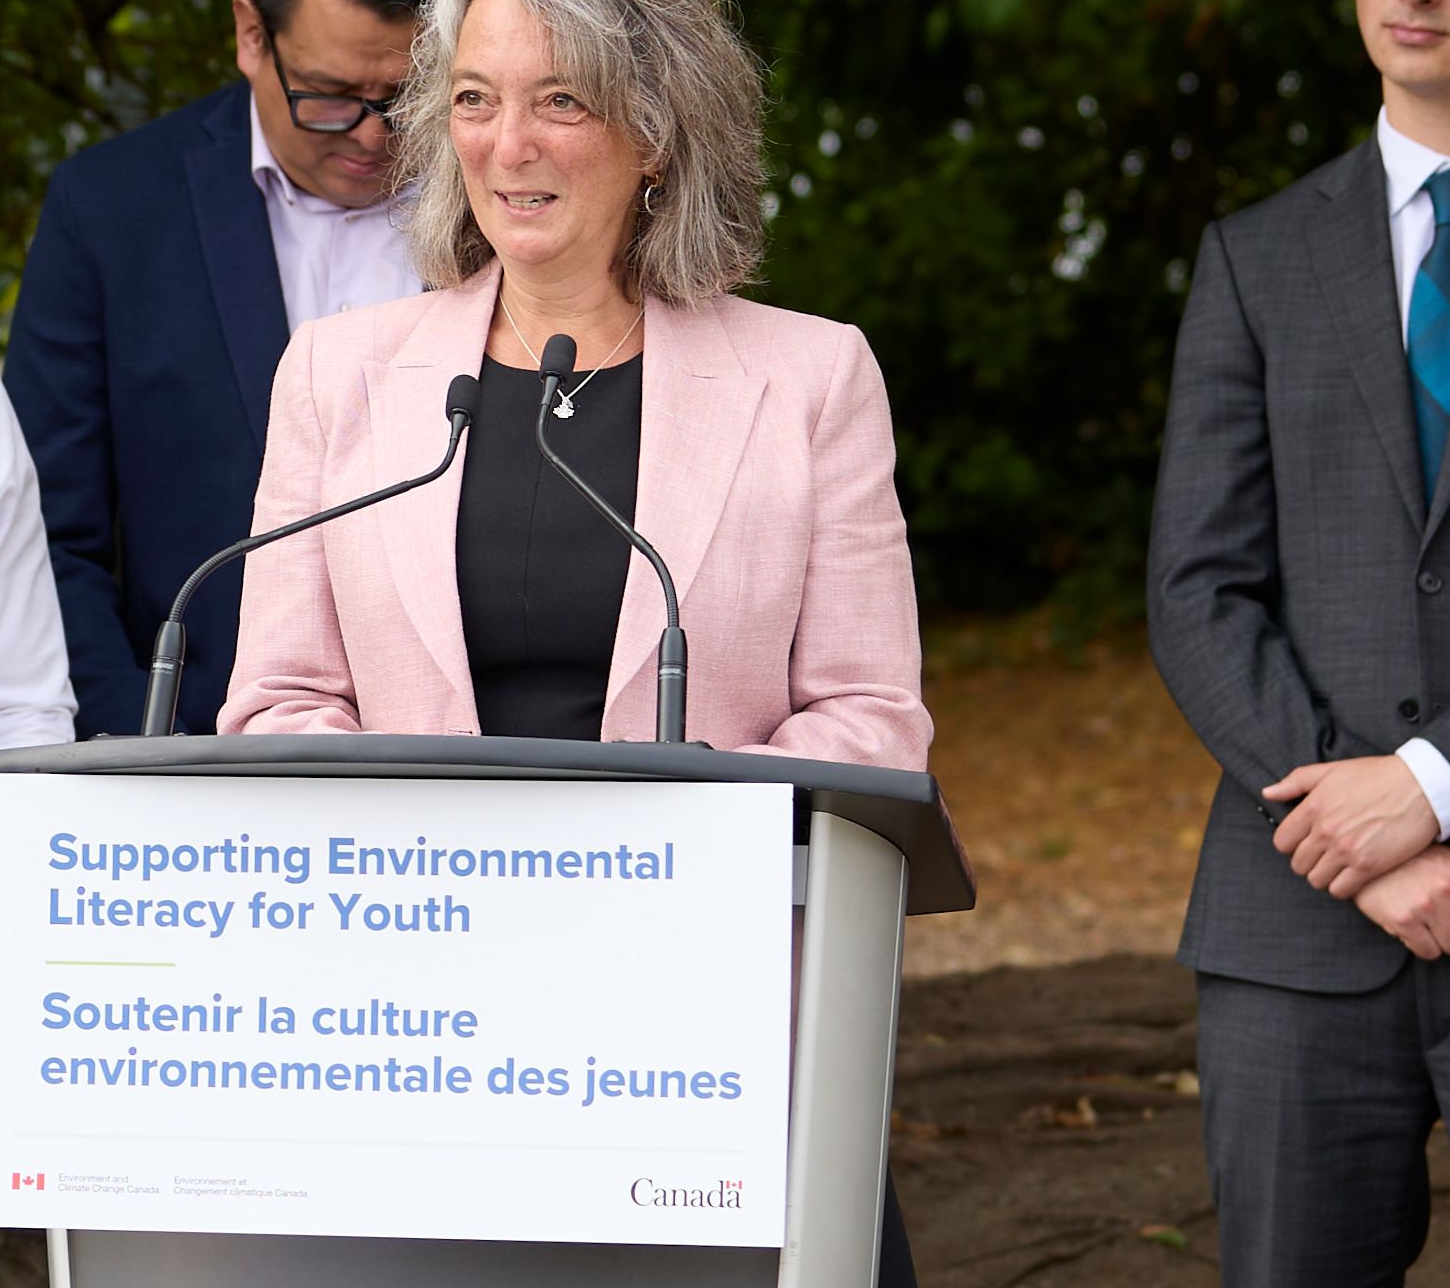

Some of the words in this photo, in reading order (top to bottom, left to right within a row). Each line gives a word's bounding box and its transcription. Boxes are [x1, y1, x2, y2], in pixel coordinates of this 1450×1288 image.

[48, 832, 311, 885] Supporting
[328, 835, 674, 880] Environmental
[49, 885, 236, 939] Literacy
[247, 891, 315, 930] for
[327, 892, 470, 933] Youth
[41, 991, 243, 1033] Soutenir
[258, 996, 296, 1035] la
[311, 998, 478, 1039] culture
[40, 1046, 472, 1094] environnementale
[487, 1057, 570, 1096] des
[581, 1056, 742, 1107] jeunes
[58, 1173, 110, 1182] Environment
[112, 1175, 129, 1183] and
[58, 1183, 90, 1192] Climate
[92, 1184, 125, 1195] Change
[126, 1185, 160, 1194] Canada
[173, 1186, 228, 1196] Changement
[229, 1187, 273, 1198] climatique
[275, 1188, 308, 1198] Canada
[174, 1176, 237, 1186] Environnement
[238, 1178, 247, 1186] et
[630, 1177, 742, 1209] Canada
